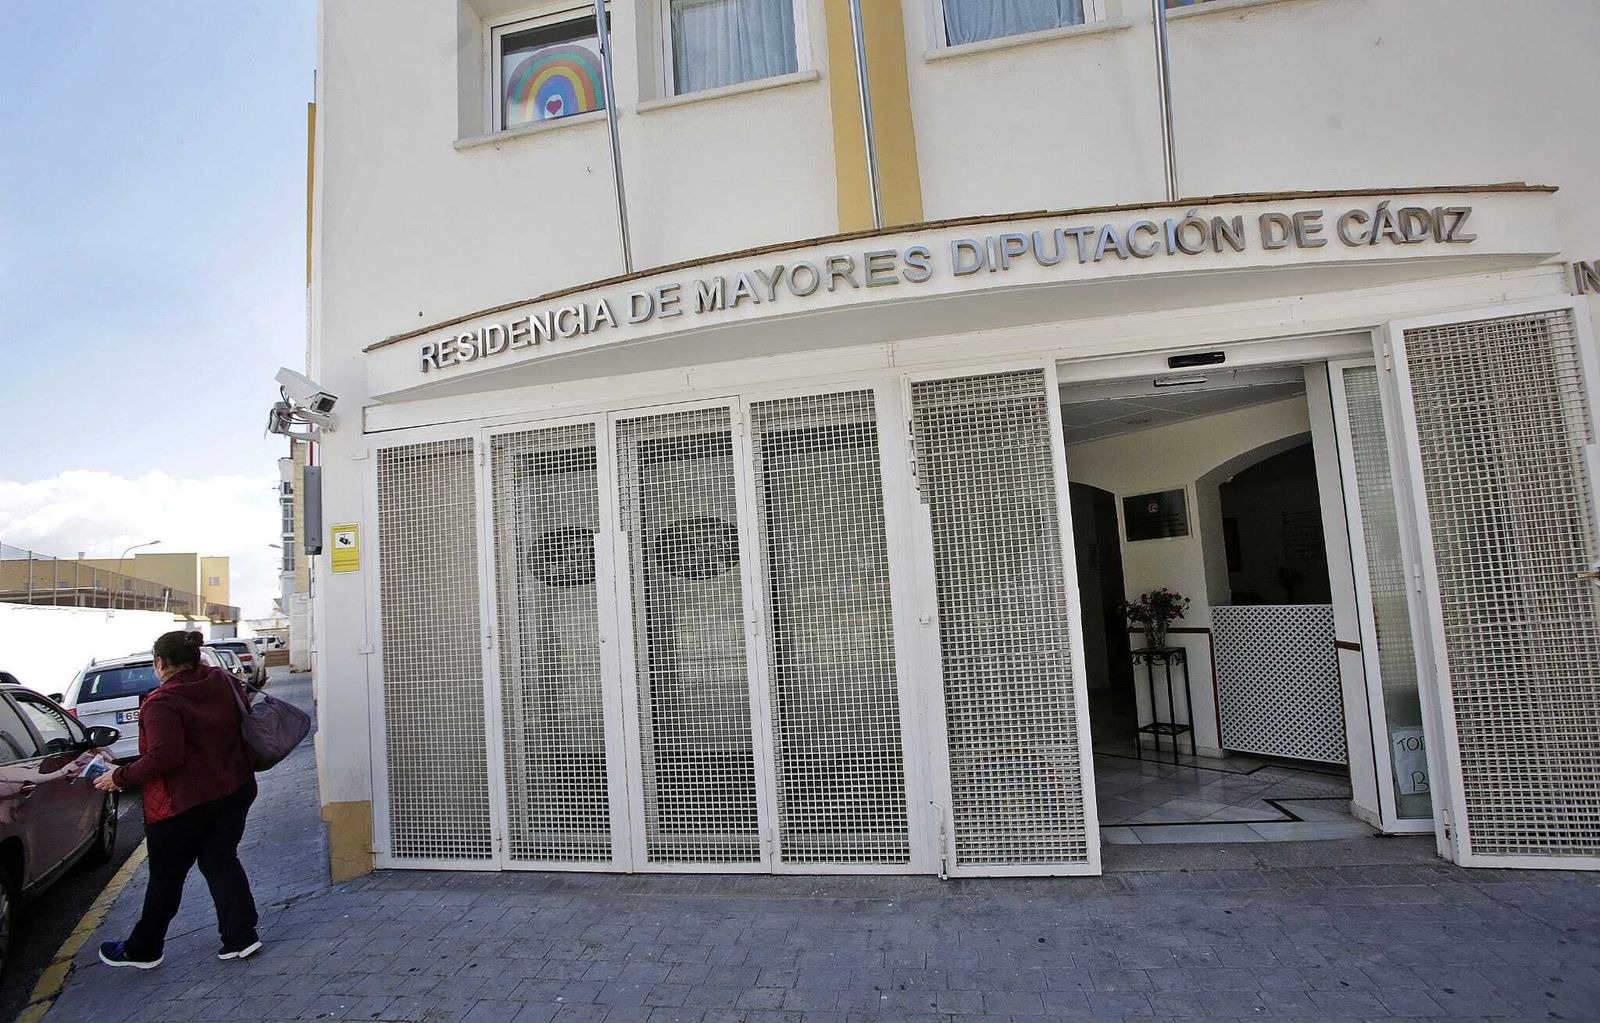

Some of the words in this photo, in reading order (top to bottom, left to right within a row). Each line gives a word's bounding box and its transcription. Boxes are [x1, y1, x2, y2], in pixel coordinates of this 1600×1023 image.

[421, 298, 618, 373] RESIDENCIA
[628, 283, 681, 324] DE
[694, 245, 933, 314] MAYORES
[951, 208, 1246, 275] DIPUTACIÓN
[1259, 210, 1327, 250] DE
[1337, 201, 1477, 247] CÁDIZ
